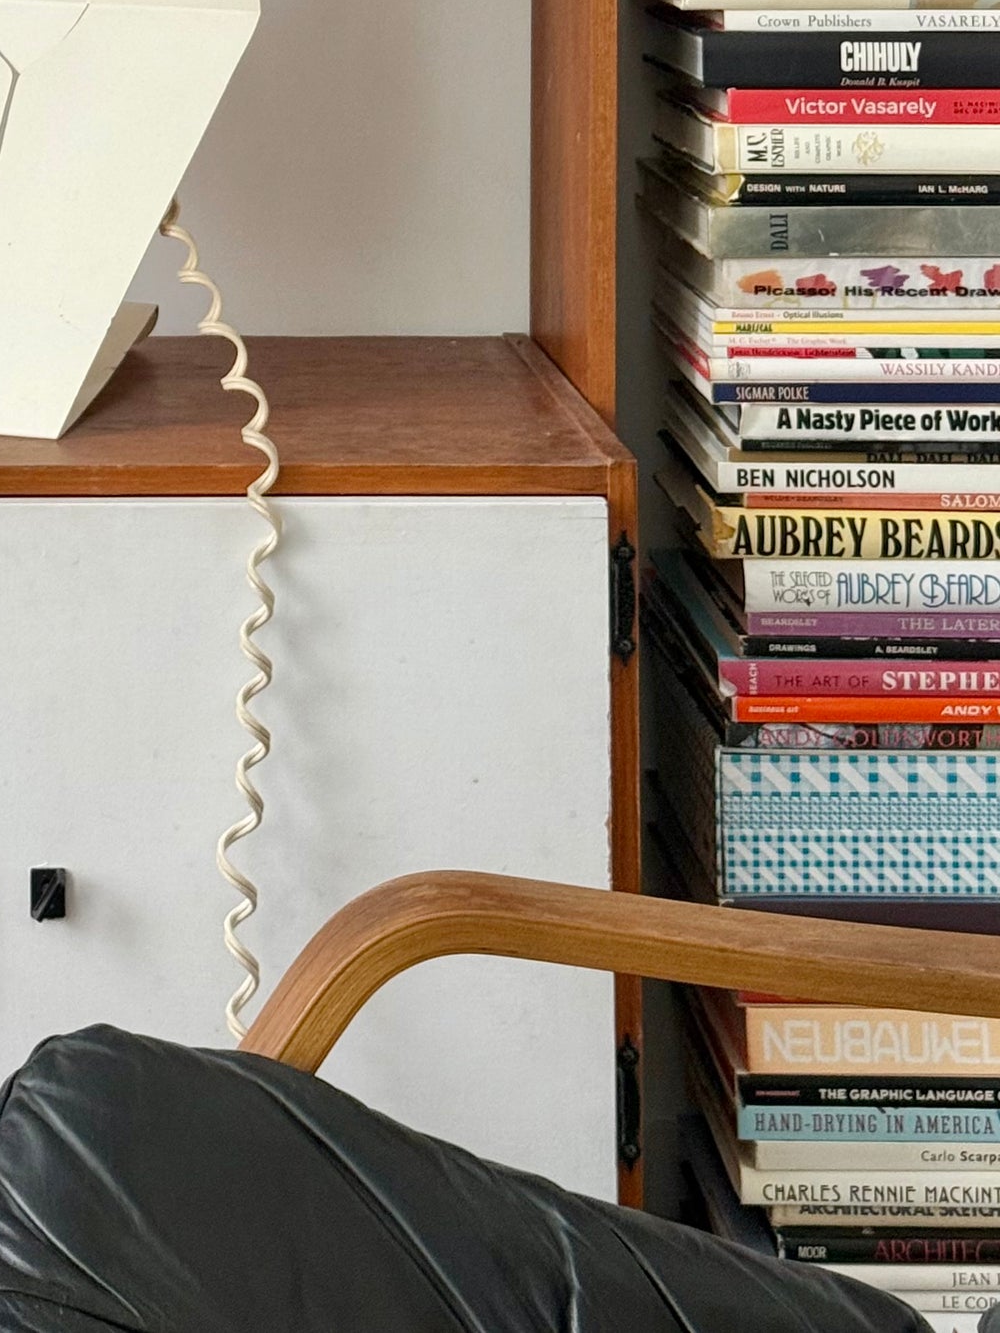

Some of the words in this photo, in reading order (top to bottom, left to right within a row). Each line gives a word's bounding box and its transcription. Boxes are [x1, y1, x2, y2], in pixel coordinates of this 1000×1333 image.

[757, 16, 800, 27] Crown
[808, 15, 872, 28] Publishers
[915, 14, 1000, 27] VASARELY
[840, 41, 922, 73] CHIHULY
[840, 77, 875, 86] Donald
[877, 77, 887, 86] B.
[785, 96, 847, 115] Victor
[851, 97, 937, 118] Vasarely
[770, 128, 785, 168] ESCHER
[746, 183, 781, 193] DESIGN
[809, 183, 846, 193] NATURE
[918, 185, 935, 193] IAN
[938, 185, 946, 194] L.
[948, 185, 988, 194] McHARG
[770, 213, 789, 251] DALI
[753, 285, 837, 297] Picasso:
[844, 285, 875, 297] His
[881, 285, 948, 297] Recent
[783, 311, 811, 319] Optical
[812, 311, 844, 319] Illusions
[880, 363, 946, 376] WASSILY
[735, 386, 776, 400] SIGMAR
[778, 386, 809, 400] POLKE
[776, 408, 792, 429] A
[796, 409, 855, 433] Nasty
[860, 409, 916, 431] Piece
[920, 409, 942, 431] of
[945, 410, 1000, 431] Work
[737, 469, 775, 487] BEN
[785, 469, 896, 489] NICHOLSON
[732, 514, 868, 557] AUBREY
[770, 571, 785, 587] THE
[789, 570, 832, 588] SELECTED
[773, 588, 815, 606] WORKS
[816, 589, 831, 605] OF
[836, 571, 915, 607] AUBREY
[919, 572, 1000, 608] BEARD
[760, 617, 818, 626] BEARDSLEY
[897, 617, 935, 630] THE
[941, 618, 1000, 631] LATER
[769, 643, 817, 653] DRAWINGS
[874, 645, 883, 654] A.
[885, 645, 938, 654] BEARDSLEY
[774, 674, 803, 687] THE
[812, 674, 840, 687] ART
[847, 675, 870, 688] OF
[881, 670, 1000, 691] STEPHE
[940, 705, 992, 716] ANDY
[761, 728, 821, 747] ANDY
[818, 1088, 847, 1100] THE
[850, 1089, 913, 1101] GRAPHIC
[916, 1090, 995, 1101] LANGUAGE
[754, 1112, 878, 1134] HAND-DRYING
[887, 1114, 904, 1133] IN
[914, 1115, 994, 1134] AMERICA
[920, 1150, 955, 1162] Carlo
[763, 1183, 841, 1201] CHARLES
[850, 1185, 917, 1202] RENNIE
[951, 1272, 991, 1287] JEAN
[942, 1295, 960, 1309] LE
